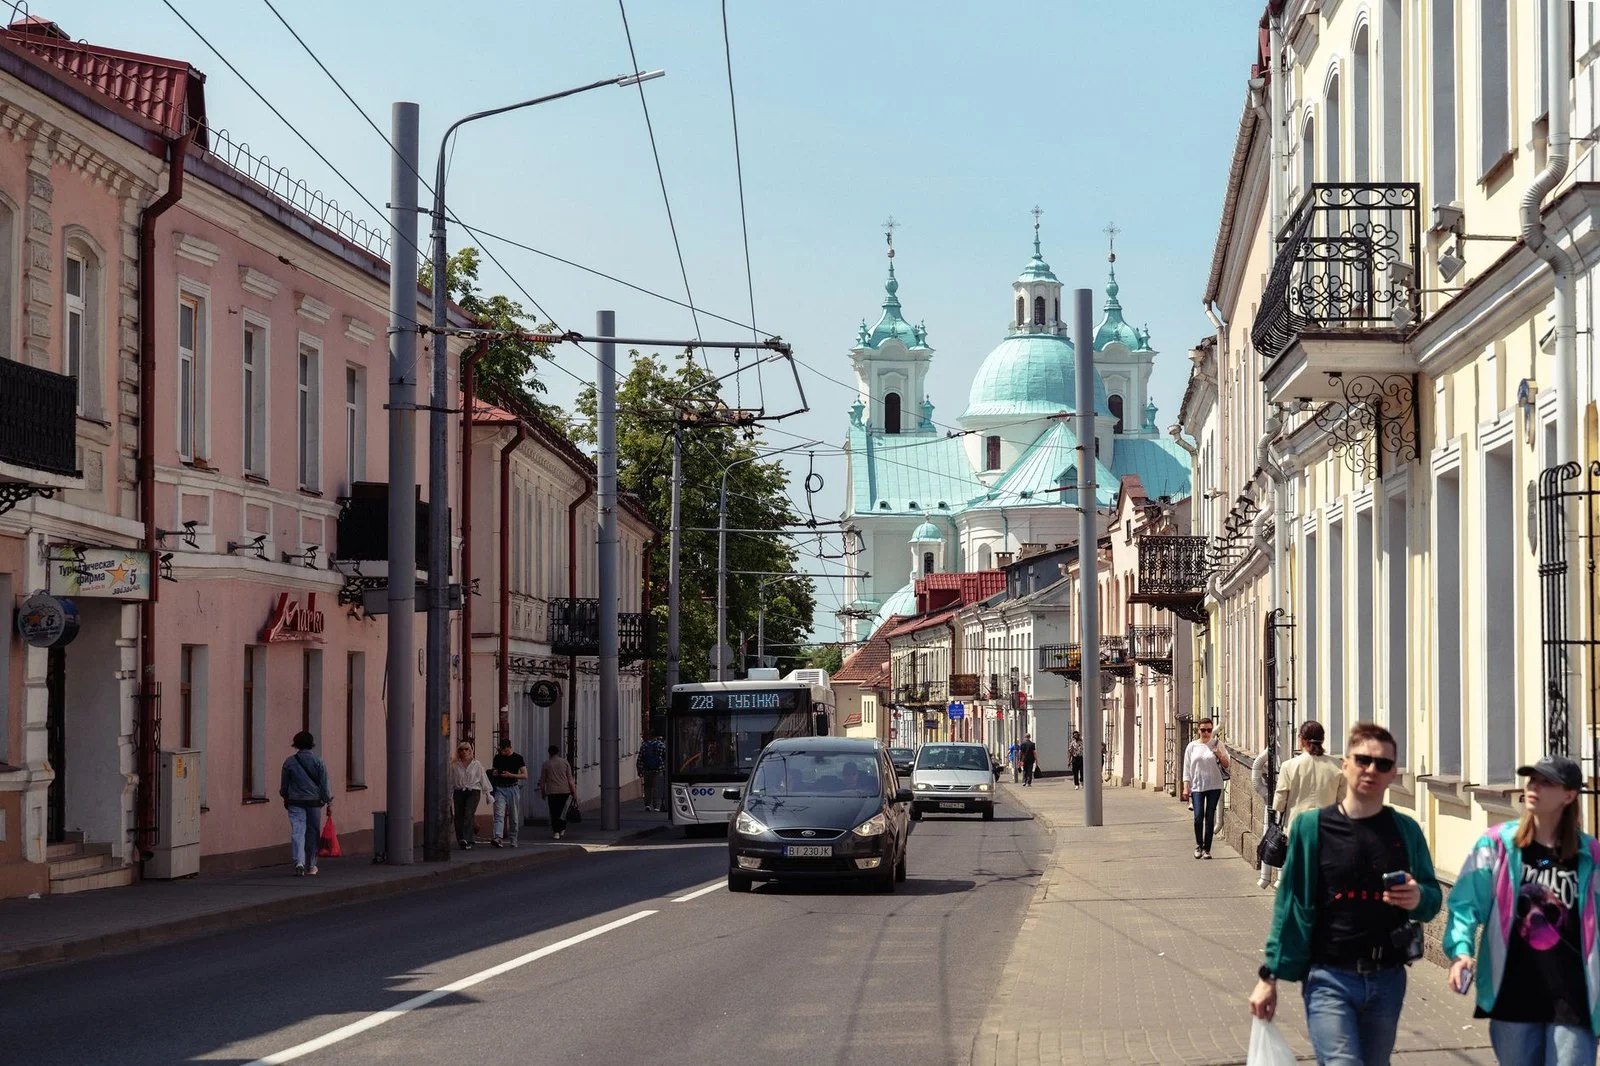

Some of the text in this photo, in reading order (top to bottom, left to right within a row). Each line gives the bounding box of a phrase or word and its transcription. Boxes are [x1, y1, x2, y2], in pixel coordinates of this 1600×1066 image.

[59, 560, 115, 576] Туртическая
[77, 573, 105, 586] фирма
[129, 568, 137, 585] 5
[691, 695, 714, 710] 228
